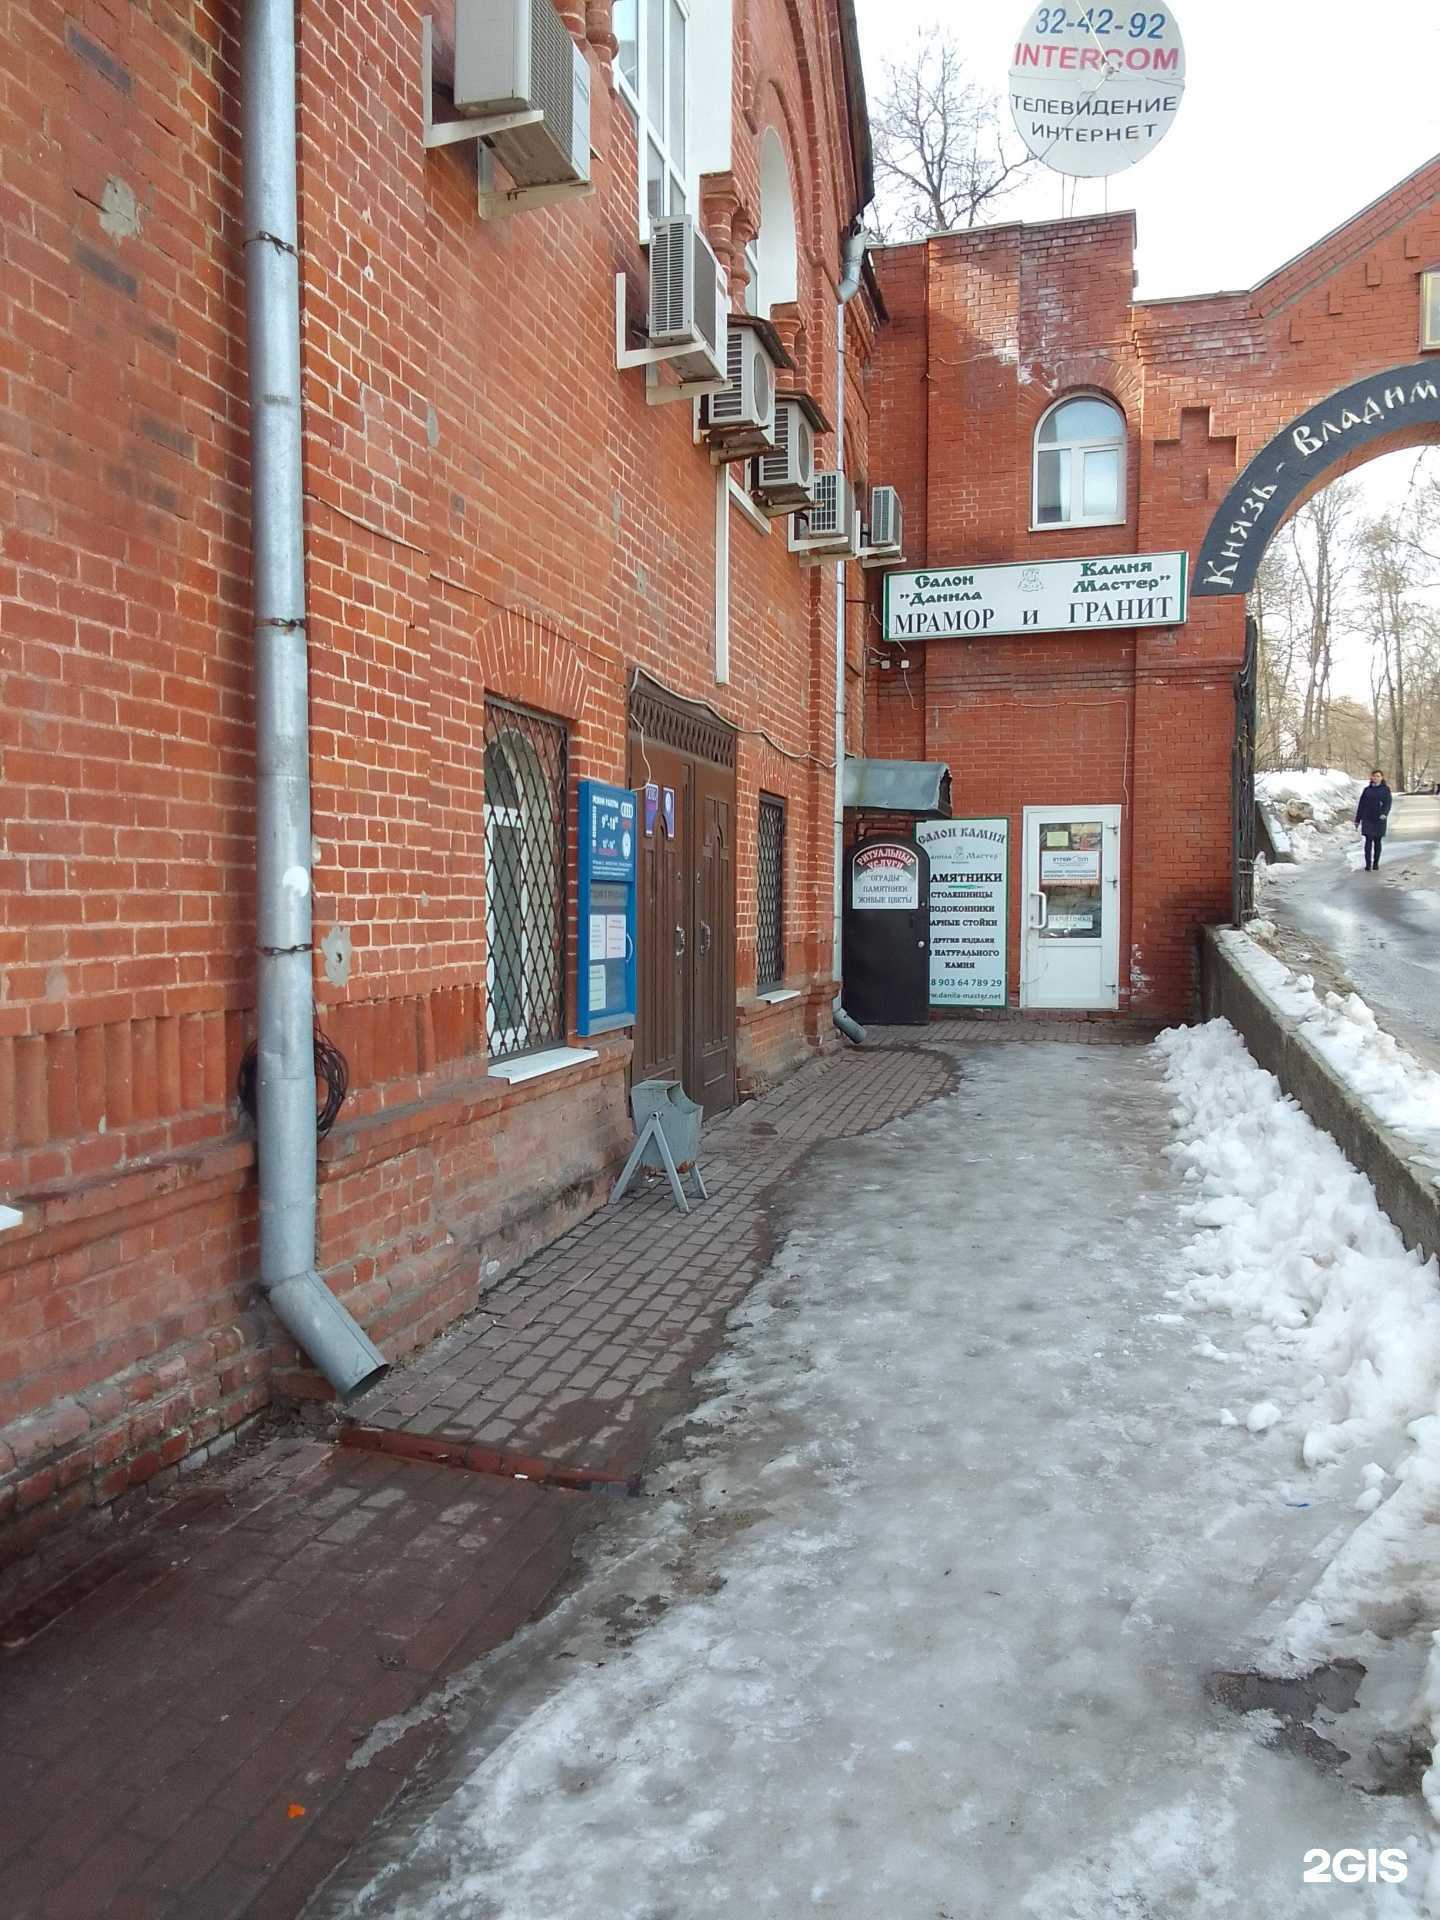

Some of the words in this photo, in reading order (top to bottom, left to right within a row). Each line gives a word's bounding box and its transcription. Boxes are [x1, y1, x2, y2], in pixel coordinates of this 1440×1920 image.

[1036, 8, 1166, 39] 32-42-92
[1014, 42, 1179, 71] INTERCOM
[1012, 94, 1177, 116] ТЕЛЕВИДЕНИЕ
[1031, 121, 1158, 142] ИНТЕРНЕТ
[1080, 561, 1153, 577] Камня
[894, 608, 995, 635] МРАМОР
[1068, 596, 1173, 624] ГРАНИТ
[918, 828, 956, 845] САЛОН
[961, 828, 1005, 843] КАМНЯ
[856, 848, 915, 866] РИТУАЛЬНЫЕ
[867, 859, 904, 869] УСЛУГИ
[930, 873, 1002, 883] АМЯТНИКИ
[962, 917, 998, 927] СТОЙКИ
[934, 949, 1000, 957] НАТУРАЛЬНОГО
